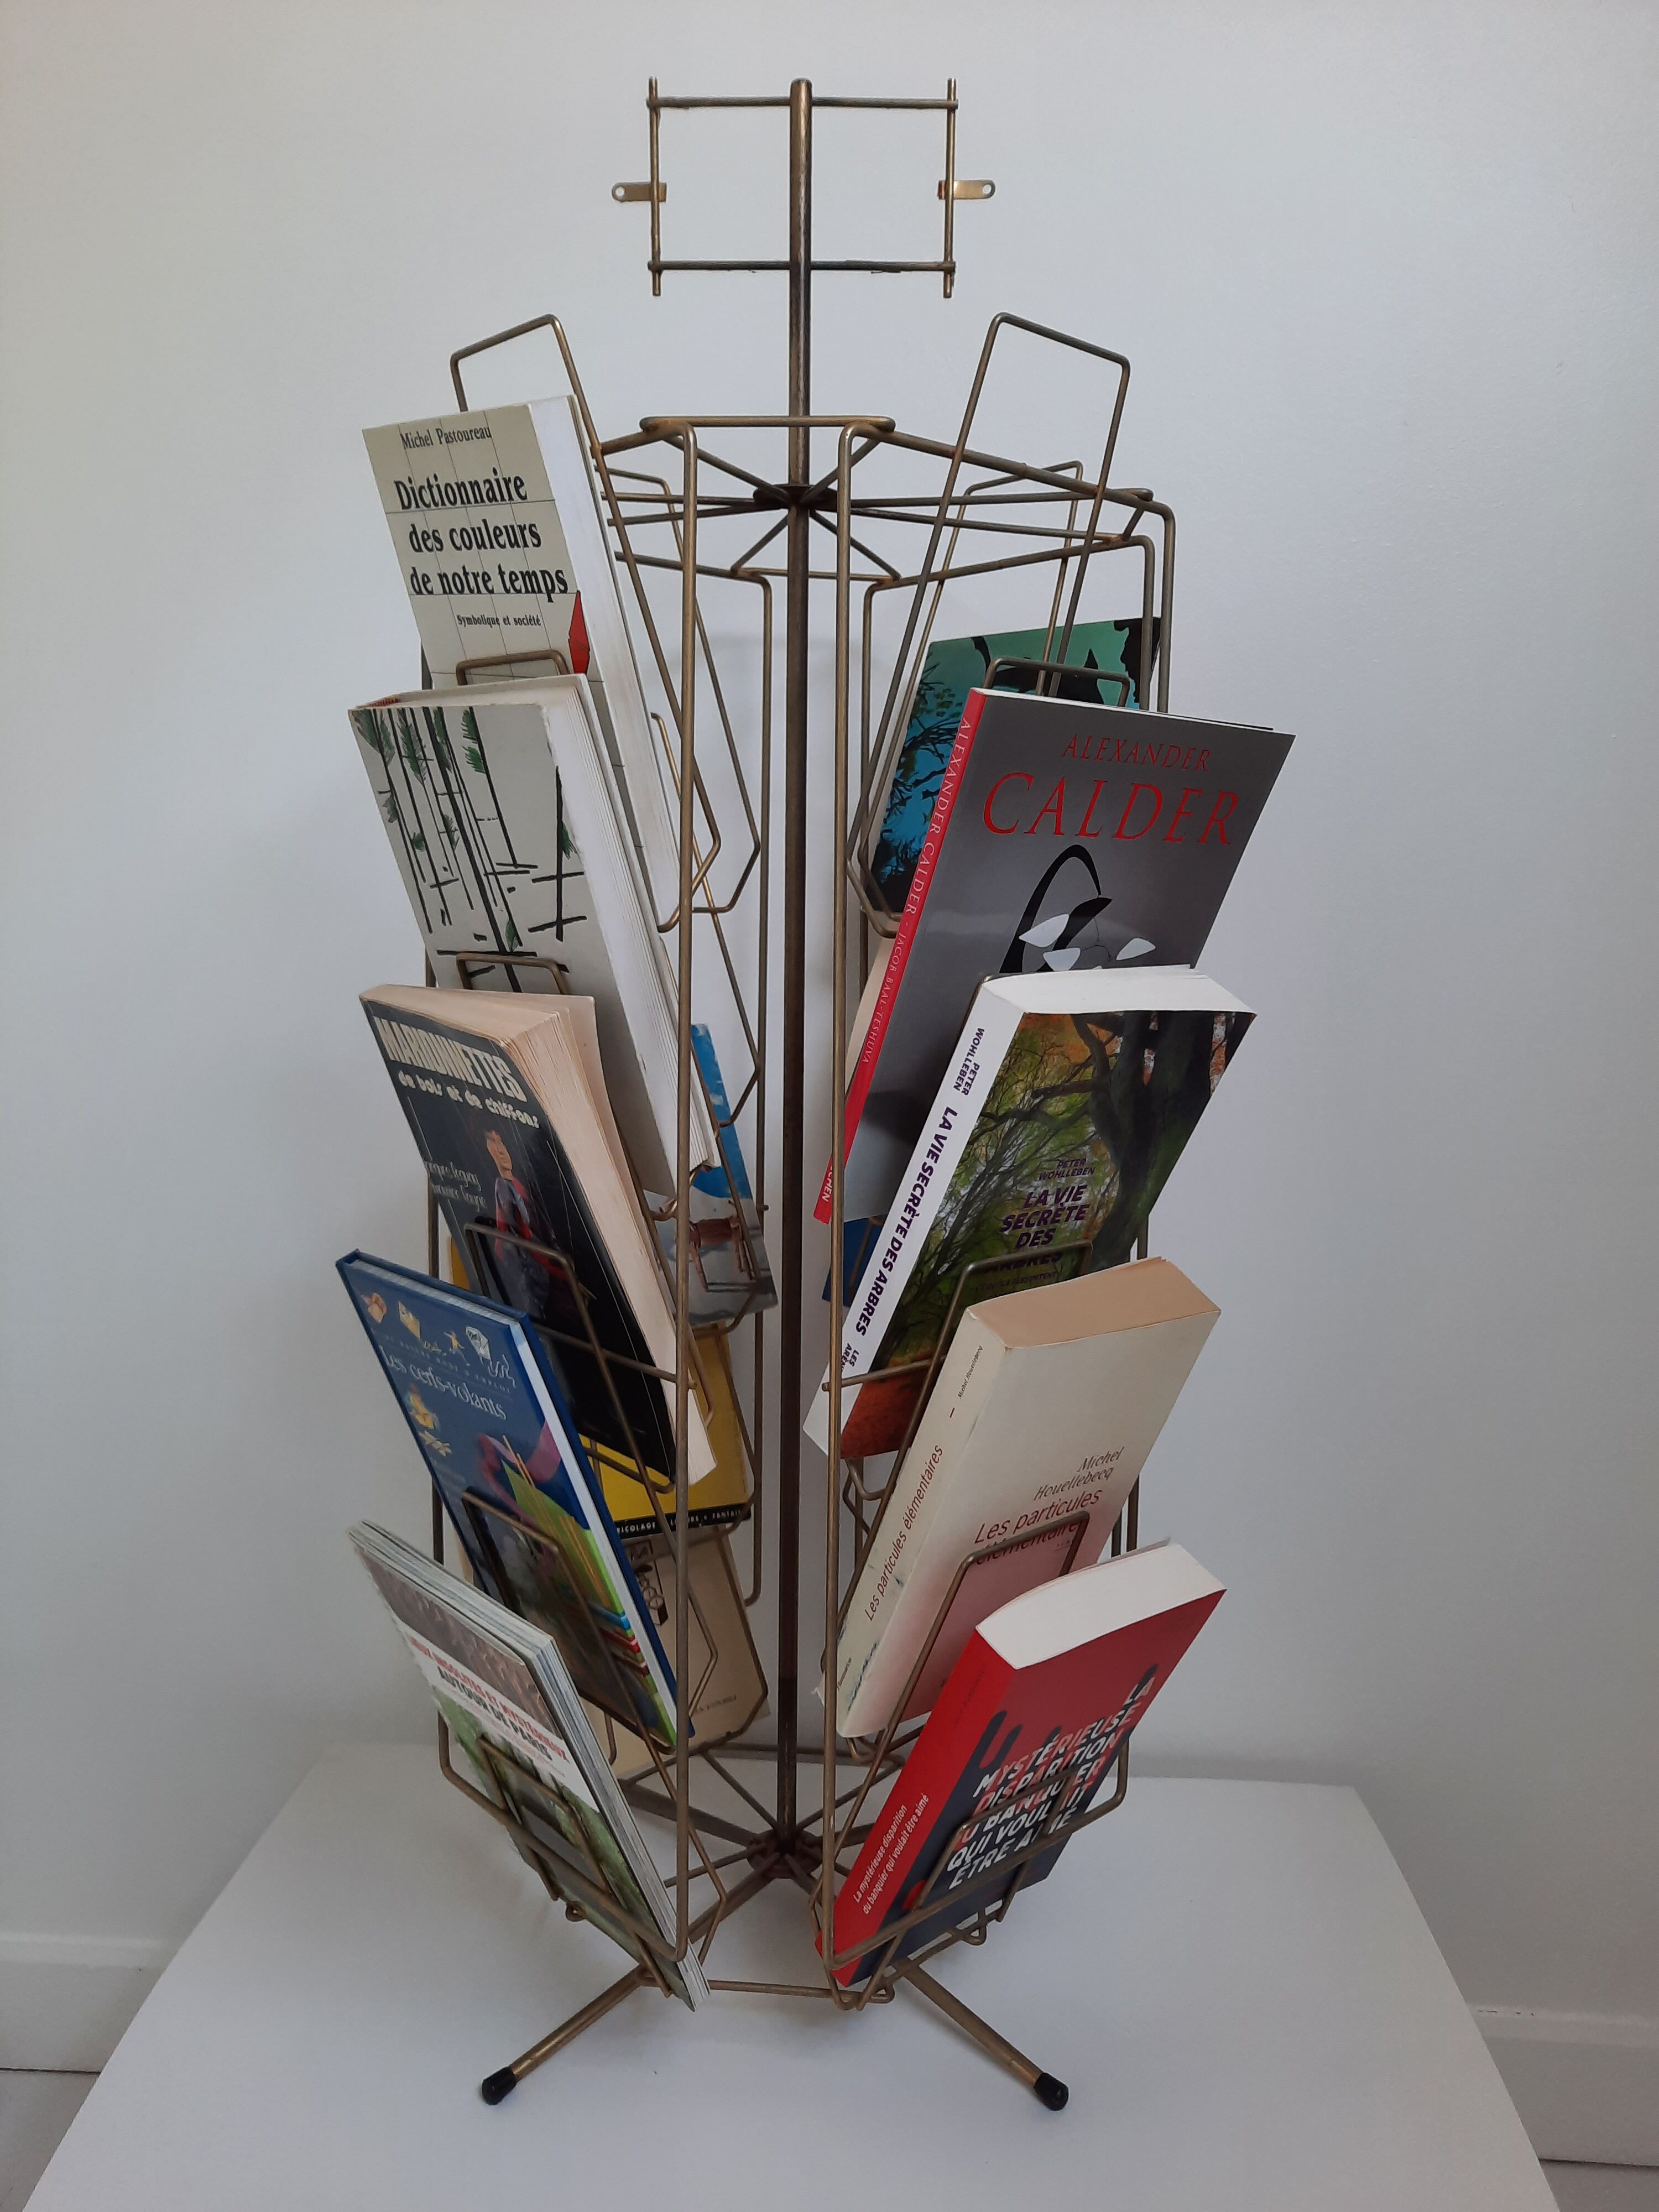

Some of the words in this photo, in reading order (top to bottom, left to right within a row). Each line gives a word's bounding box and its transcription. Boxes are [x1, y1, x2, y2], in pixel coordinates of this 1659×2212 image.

[400, 429, 434, 450] Michel
[435, 426, 492, 445] Pastoureau
[393, 467, 528, 510] Dictionnaire
[409, 523, 444, 553] des
[449, 518, 542, 551] couleurs
[410, 567, 434, 596] de
[438, 564, 494, 595] notre
[498, 563, 568, 603] temps
[457, 614, 500, 628] Symbolique
[503, 616, 511, 626] et
[514, 614, 541, 627] société
[1062, 734, 1211, 772] ALEXANDER
[929, 717, 972, 834] ALEXANDER
[983, 772, 1239, 846] CALDER
[905, 842, 935, 915] CALDER
[373, 1016, 528, 1102] MARIONNETTES
[953, 1027, 985, 1091] WOHLLEBEN
[446, 1085, 463, 1103] et
[961, 1062, 980, 1095] PETER
[938, 1107, 958, 1130] LA
[926, 1133, 948, 1164] VIE
[1056, 1158, 1087, 1169] PETER
[1037, 1167, 1095, 1181] WOHLLEBEN
[895, 1161, 934, 1239] SECRÈTE
[1022, 1190, 1049, 1209] LA
[1053, 1185, 1088, 1204] VIE
[999, 1202, 1091, 1233] SECRÈTE
[882, 1236, 903, 1272] DES
[1015, 1228, 1056, 1249] DES
[855, 1269, 888, 1336] ARBRES
[849, 1349, 859, 1367] LES
[410, 1366, 507, 1420] cerfs-volants
[1077, 1447, 1124, 1472] Michel
[1033, 1467, 1114, 1501] Houellebecq
[865, 1595, 880, 1621] Les
[877, 1531, 907, 1597] particules
[902, 1444, 943, 1531] élémentaires
[974, 1519, 1011, 1544] Les
[1013, 1490, 1102, 1534] particules
[1123, 1677, 1155, 1705] LA
[973, 1702, 1142, 1798] MYSTÉRIEUSE
[974, 1728, 1125, 1816] DISPARITION
[915, 1792, 930, 1817] aimé
[906, 1814, 919, 1833] être
[853, 1890, 862, 1903] La
[858, 1846, 886, 1891] mystérieuse
[883, 1804, 907, 1848] disparition
[892, 1830, 910, 1859] voulait
[947, 1832, 993, 1871] QUI
[886, 1855, 895, 1872] qui
[867, 1871, 889, 1904] banquier
[863, 1902, 872, 1915] du
